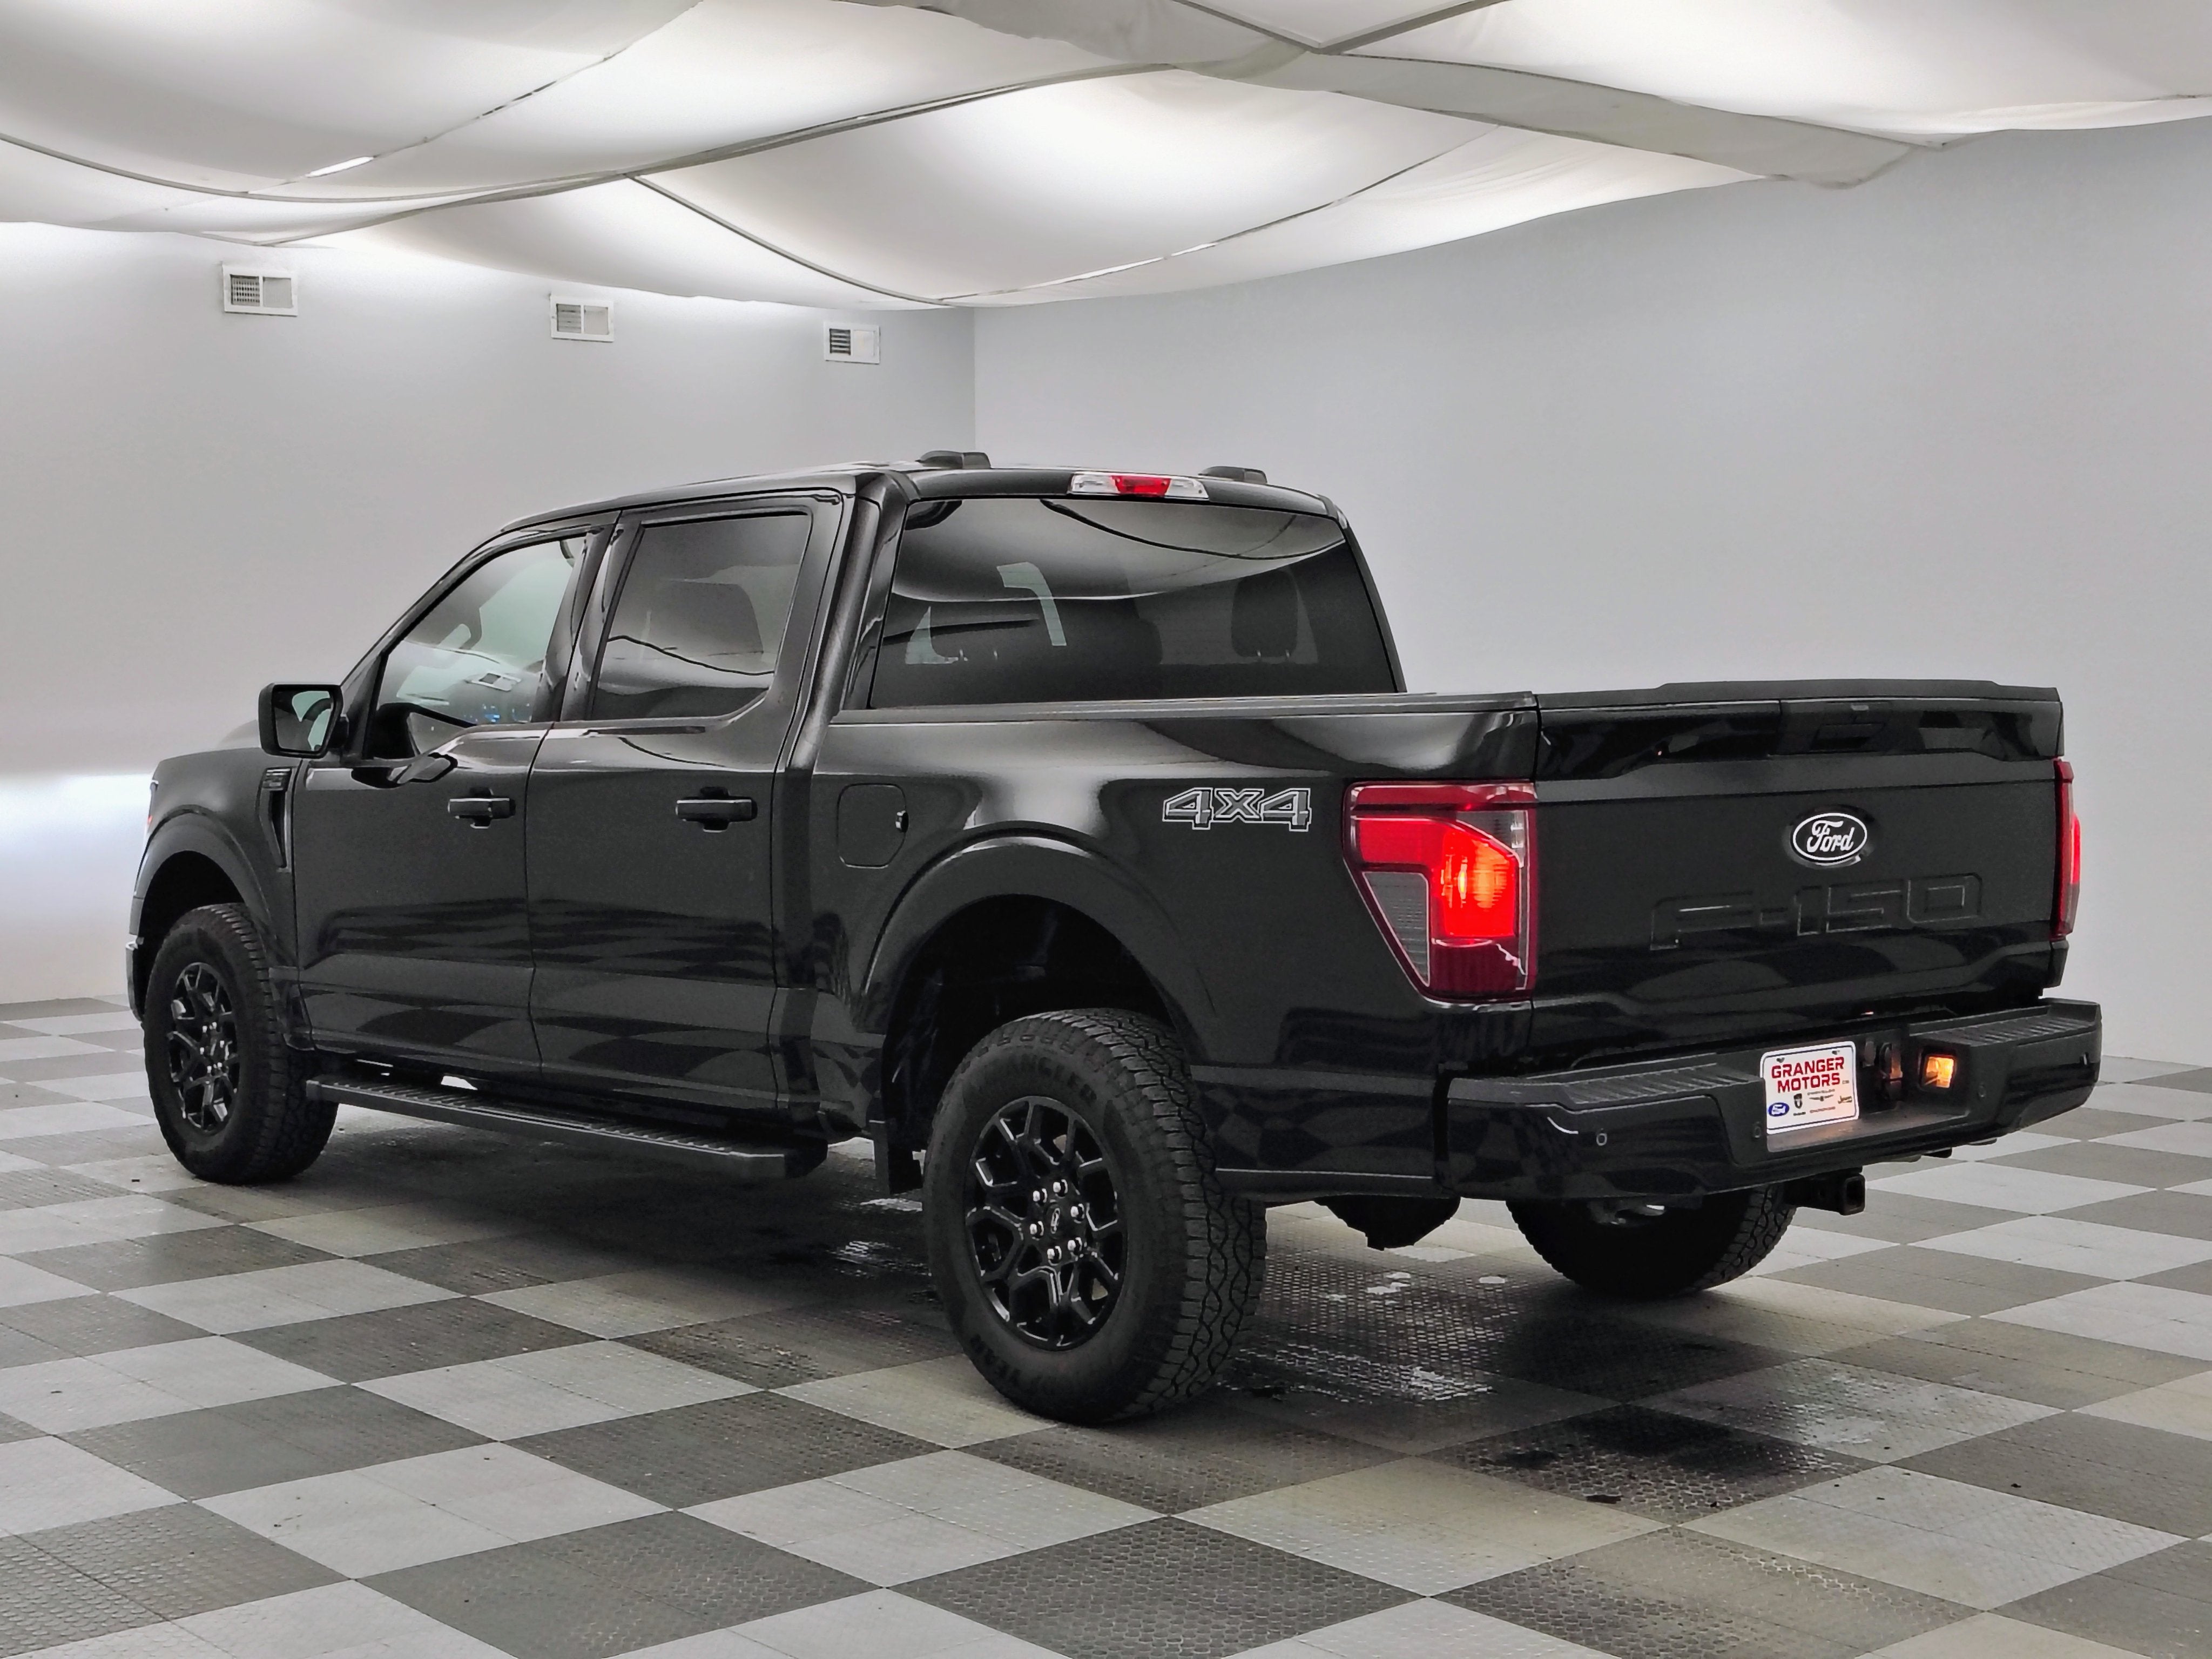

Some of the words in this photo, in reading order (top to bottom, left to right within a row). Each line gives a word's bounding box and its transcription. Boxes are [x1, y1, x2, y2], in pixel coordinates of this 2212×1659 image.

[1806, 819, 1855, 853] Ford
[1650, 872, 1984, 950] F-150
[1771, 1056, 1845, 1079] GRANGER
[1777, 1073, 1841, 1094] MOTORS
